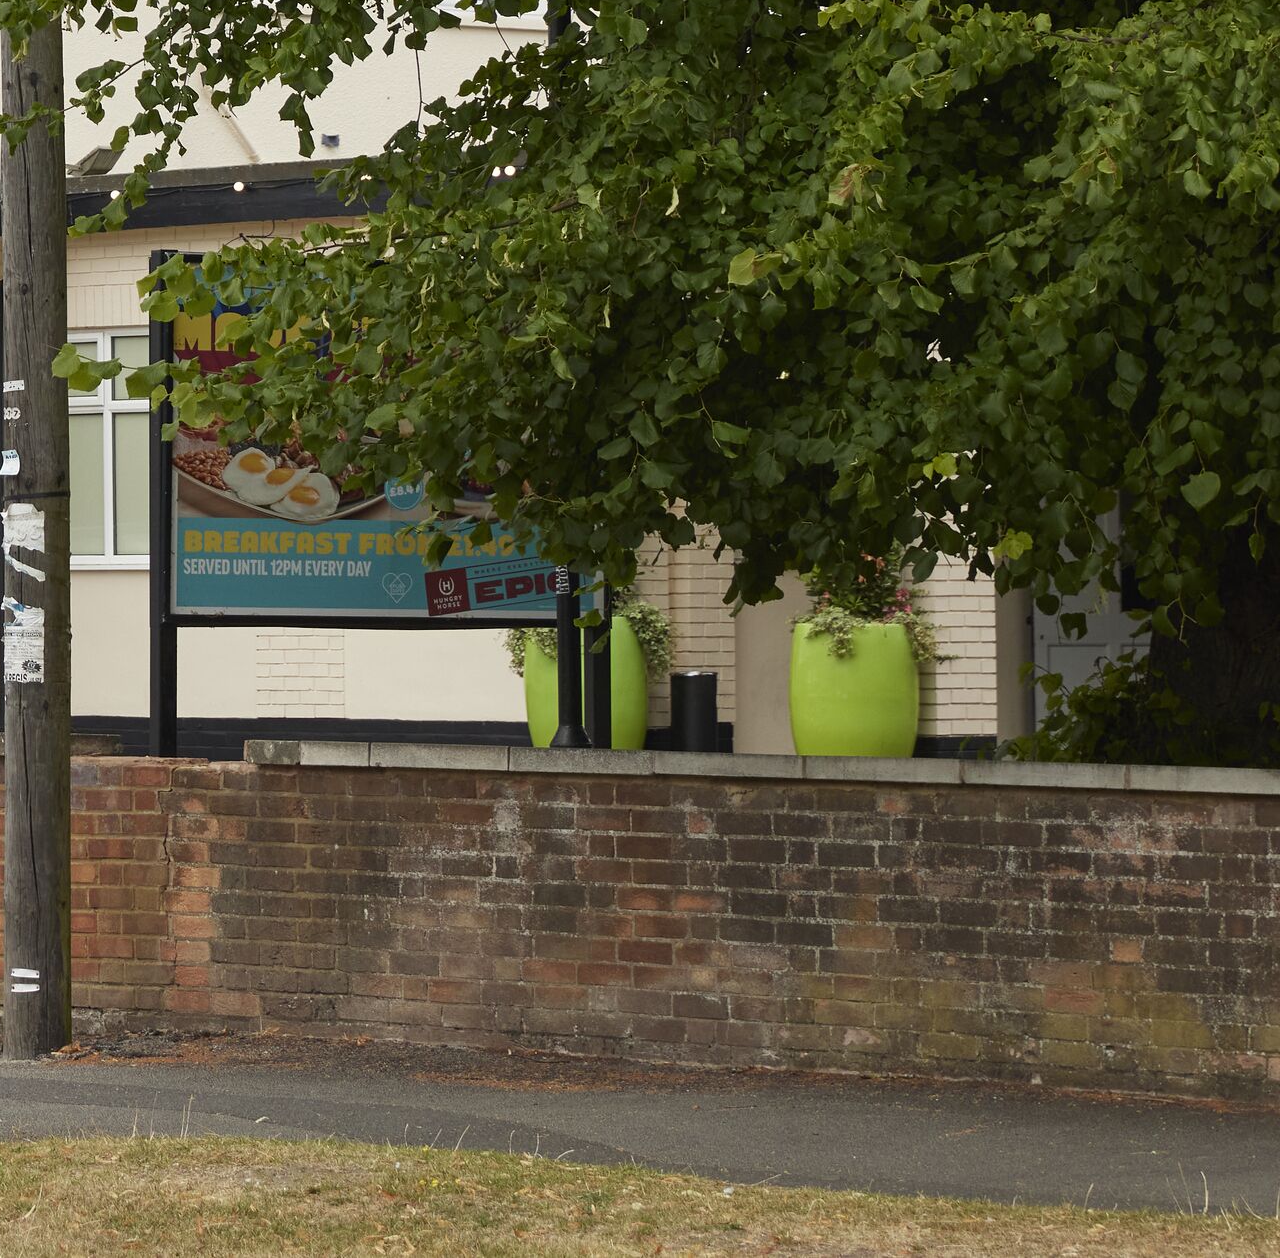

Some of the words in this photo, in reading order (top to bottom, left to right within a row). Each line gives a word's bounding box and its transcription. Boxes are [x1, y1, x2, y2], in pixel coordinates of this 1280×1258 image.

[184, 530, 352, 556] BREAKFAST
[183, 558, 230, 576] SERVED
[233, 559, 268, 576] UNTIL
[270, 560, 303, 577] 12PM
[305, 561, 343, 577] EVERY
[346, 561, 372, 578] DAY
[433, 594, 463, 605] HUNGRY
[437, 601, 461, 610] HORSE
